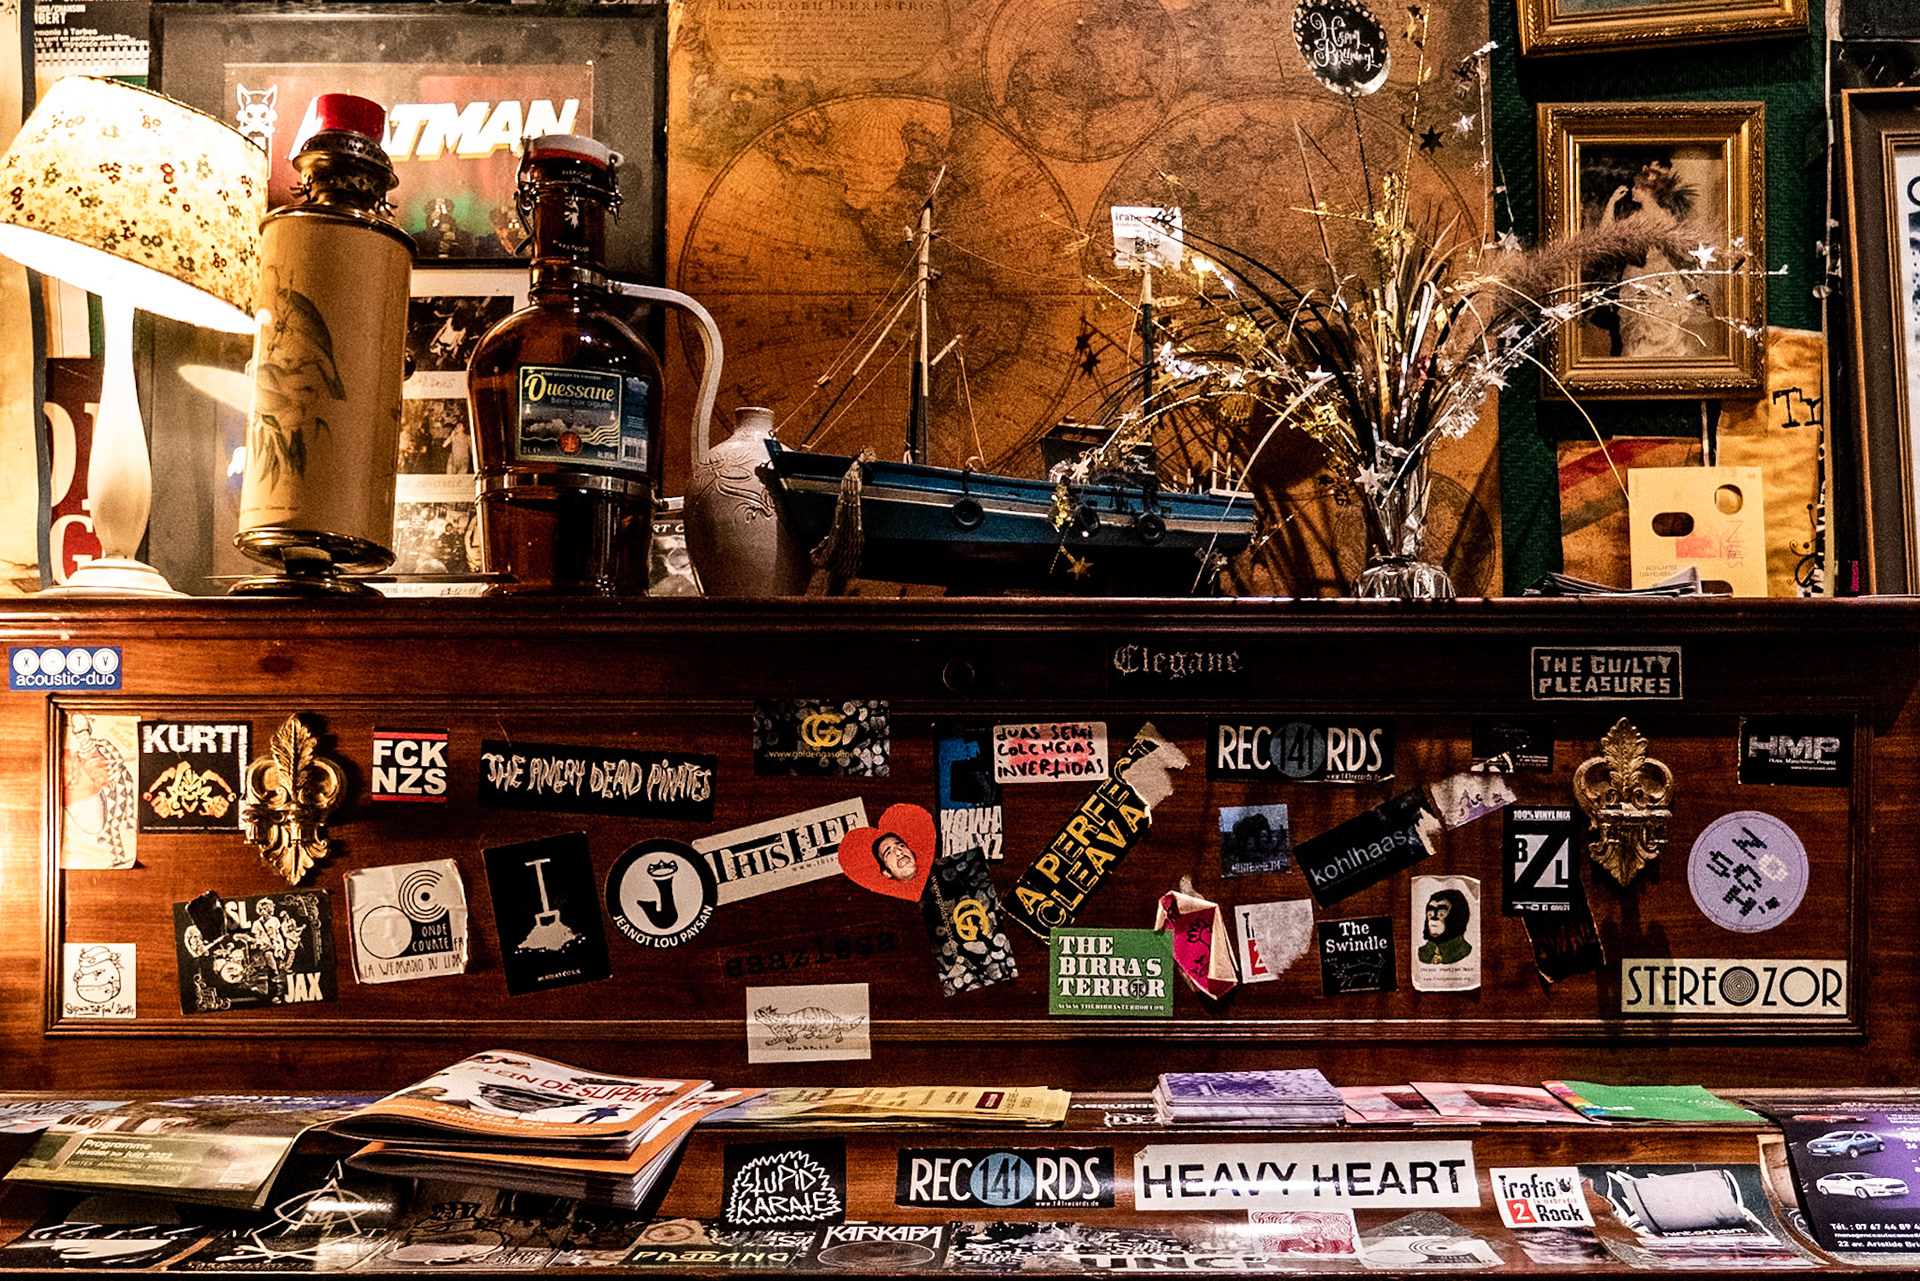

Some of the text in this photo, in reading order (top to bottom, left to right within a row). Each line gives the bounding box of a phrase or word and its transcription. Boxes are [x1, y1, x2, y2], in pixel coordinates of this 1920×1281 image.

[1113, 644, 1244, 680] Clegane
[1539, 655, 1672, 674] THE GUILTY
[15, 671, 116, 687] acoustic-duo
[1538, 677, 1672, 694] PLEASURES
[373, 739, 448, 767] FCK
[1748, 735, 1840, 760] HMP
[372, 767, 447, 794] NZS
[481, 753, 526, 792] THE
[527, 756, 586, 796] ANGRY
[589, 759, 643, 800] DEAD
[1534, 810, 1555, 820] VINYL
[1556, 810, 1571, 820] MIX
[1310, 830, 1407, 885] kohlhaas
[421, 923, 447, 938] ONDE
[613, 905, 713, 949] JEANOT LOU PAYSAN
[1339, 921, 1370, 936] The
[1058, 936, 1113, 955] THE
[1325, 936, 1388, 953] Swindle
[1058, 956, 1162, 977] BIRRA'S
[284, 972, 323, 1003] JAX
[1058, 977, 1165, 998] TERROR
[1627, 966, 1842, 1007] STEREOZOR
[469, 1066, 664, 1103] PLEIN DE SUPER
[83, 1140, 152, 1151] Programme
[124, 1150, 145, 1158] juin
[1142, 1159, 1466, 1199] HEAVY HEART
[1498, 1174, 1556, 1199] Trafic
[1513, 1202, 1584, 1222] 2 Rock
